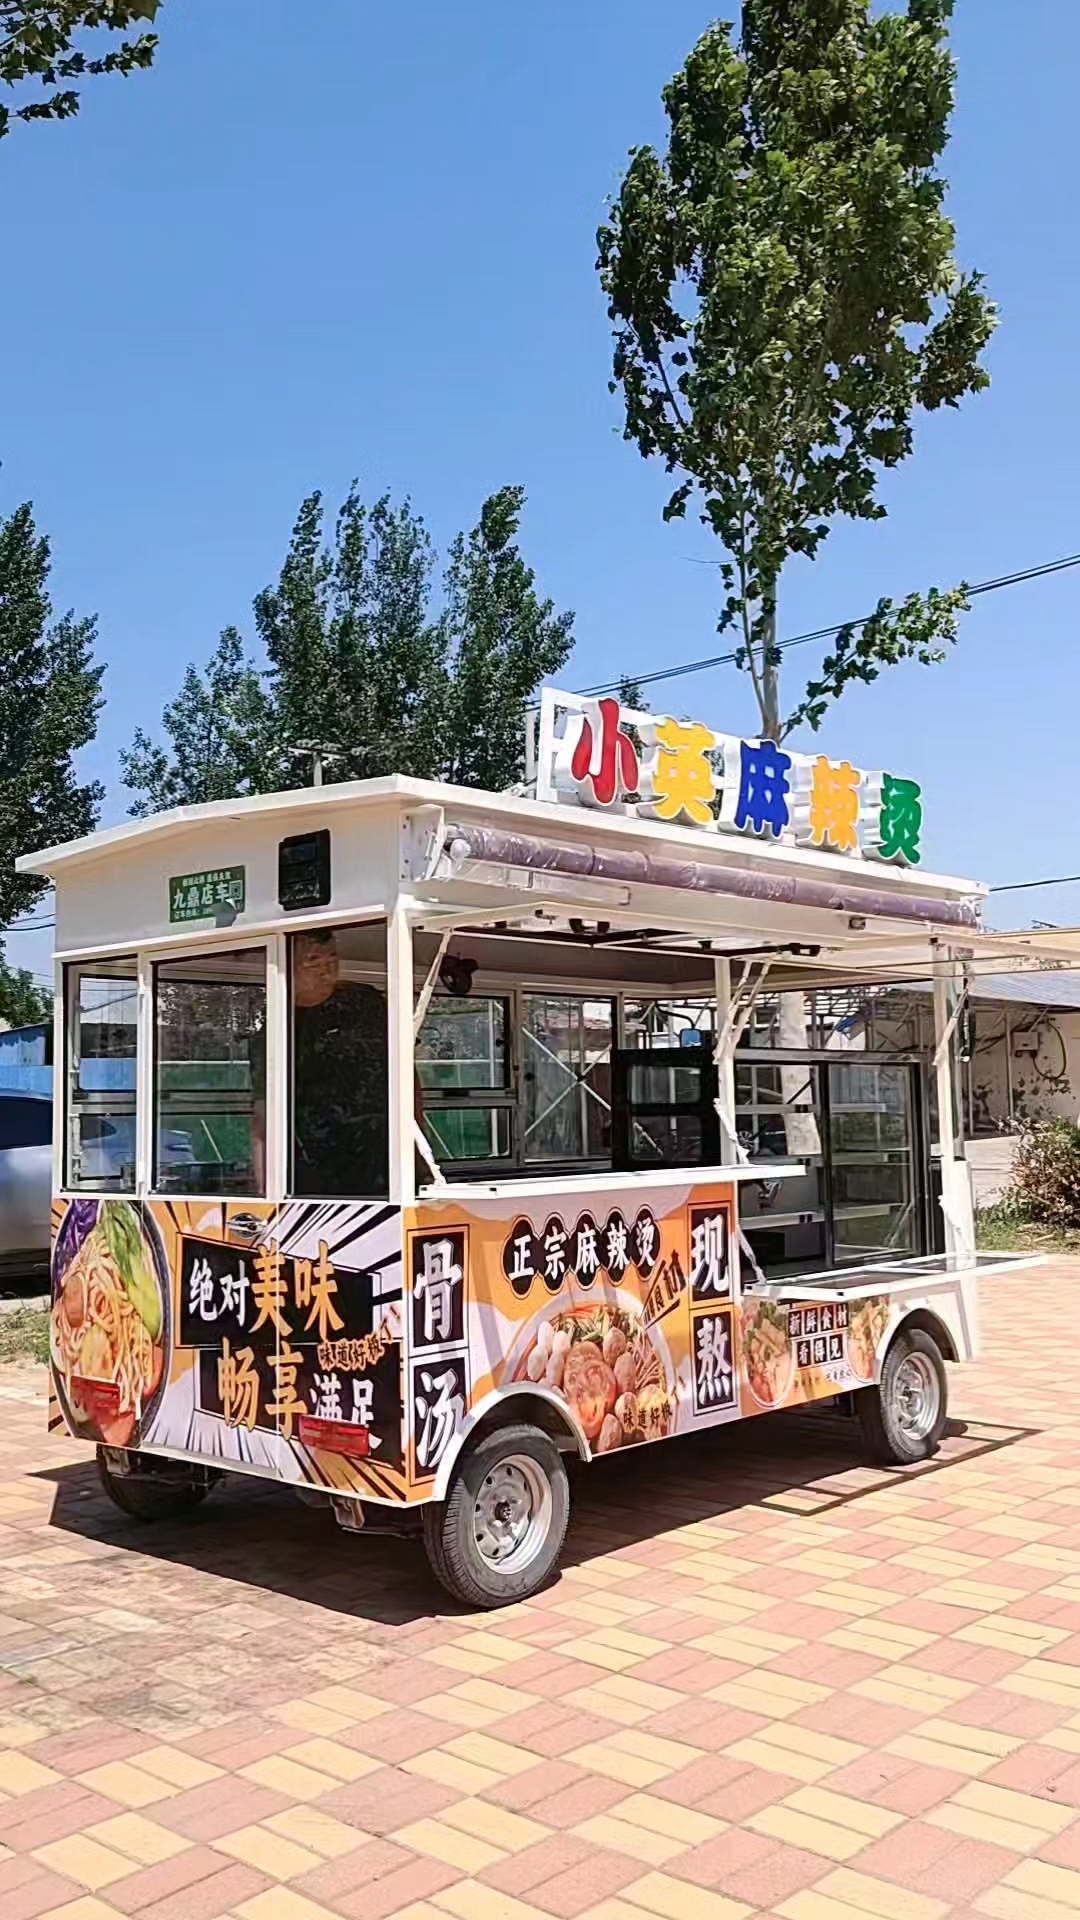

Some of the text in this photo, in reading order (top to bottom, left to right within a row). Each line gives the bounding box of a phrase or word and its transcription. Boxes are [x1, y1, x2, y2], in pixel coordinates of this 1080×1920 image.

[570, 697, 922, 865] 小英麻辣烫
[188, 1238, 345, 1339] 绝对美味
[508, 1217, 659, 1282] 正宗麻辣烫
[413, 1237, 465, 1468] 骨汤
[789, 1302, 847, 1336] 新鲜食材
